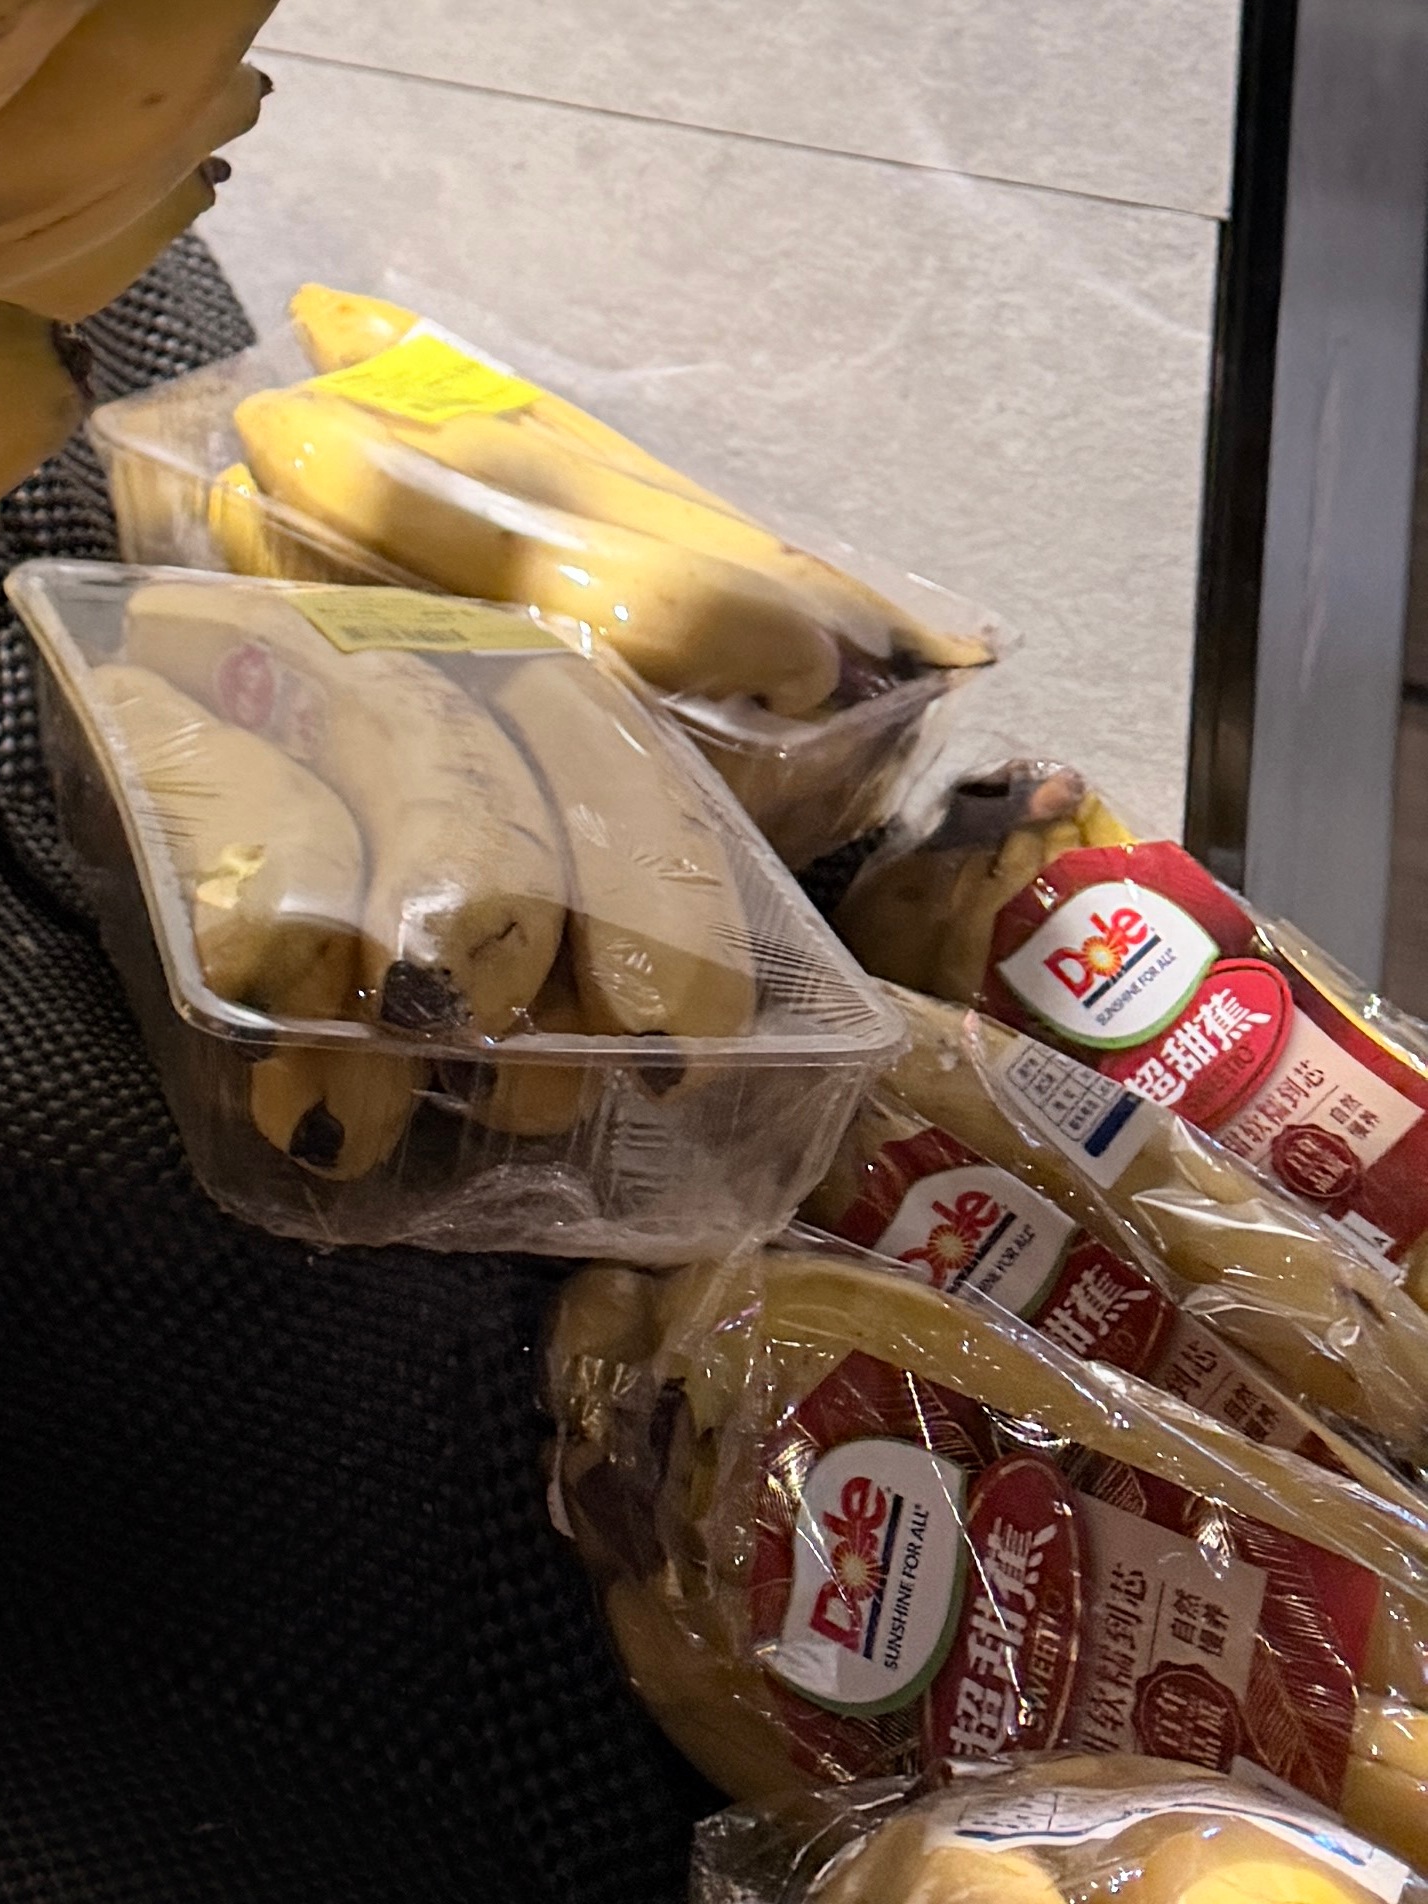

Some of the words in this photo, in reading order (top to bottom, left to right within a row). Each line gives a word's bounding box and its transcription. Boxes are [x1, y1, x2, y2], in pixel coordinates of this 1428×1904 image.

[1043, 907, 1148, 1000] Dole
[1123, 988, 1272, 1107] 超甜蕉
[808, 1475, 887, 1653] Dole
[884, 1586, 910, 1671] SUNSHINE
[904, 1540, 922, 1580] FOR
[1170, 1588, 1202, 1645] 自然
[949, 1516, 1058, 1756] 超甜蕉
